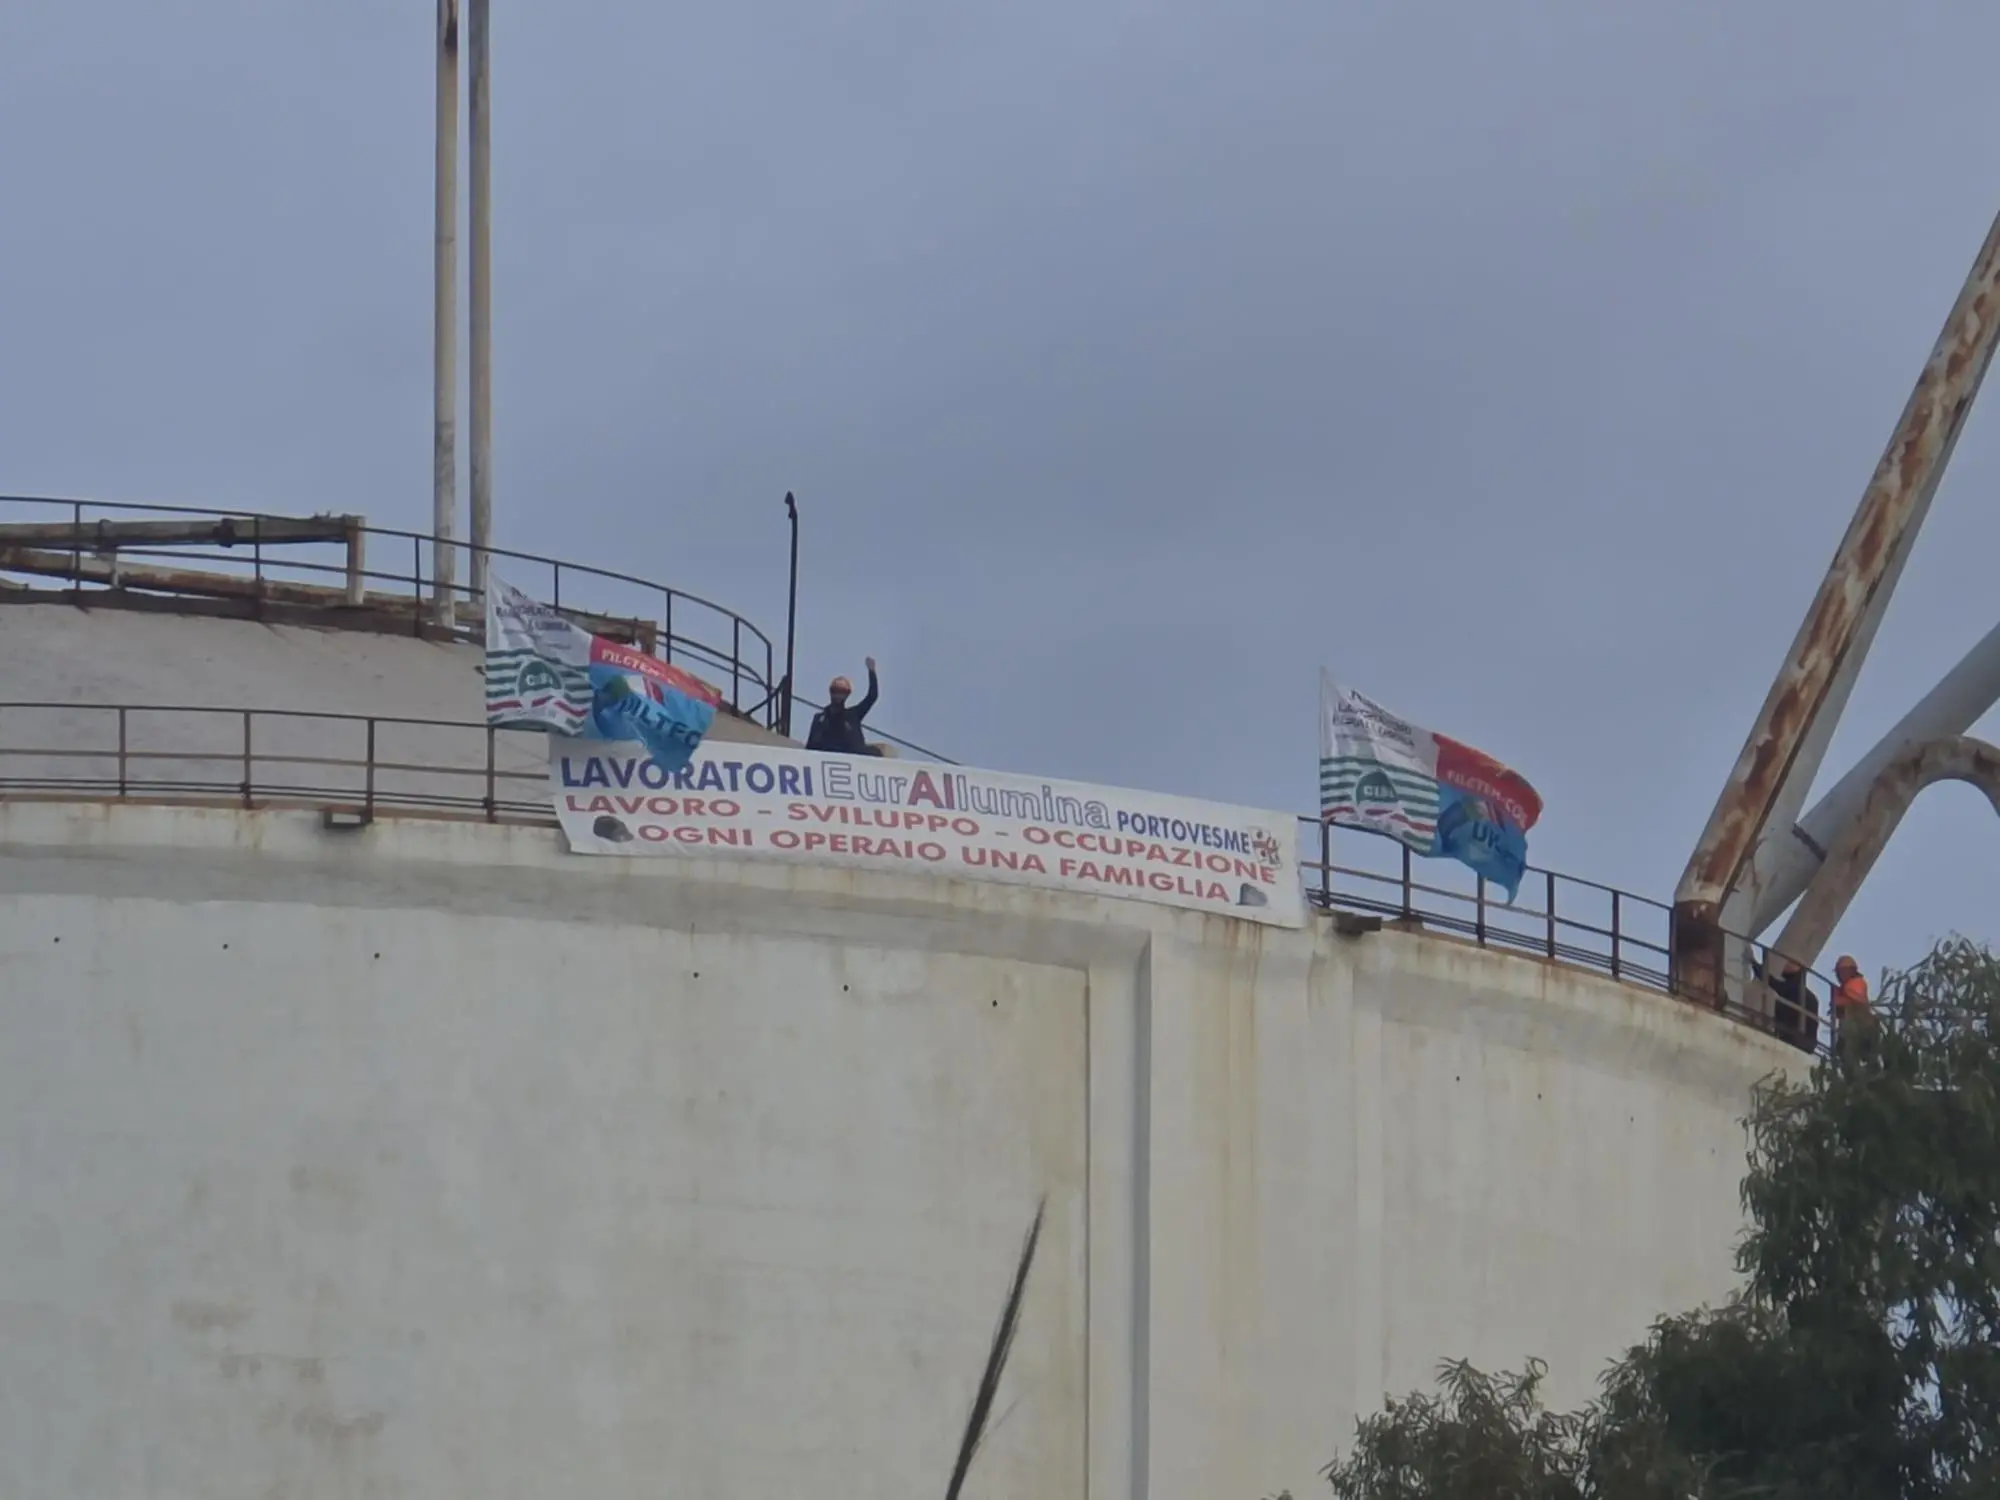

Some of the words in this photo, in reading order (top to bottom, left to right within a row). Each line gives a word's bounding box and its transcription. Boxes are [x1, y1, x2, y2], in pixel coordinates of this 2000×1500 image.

[561, 755, 812, 796] LAVORATORI
[821, 760, 1111, 830] EurAllumina
[1117, 810, 1251, 854] PORTOVESME
[566, 795, 740, 816] LAVORO
[787, 802, 980, 837] SVILUPPO
[1023, 826, 1277, 885] OCCUPAZIONE
[638, 825, 753, 846] OGNI
[769, 829, 946, 861] OPERAIO
[962, 846, 1047, 874] UNA
[1059, 858, 1231, 903] FAMIGLIA
